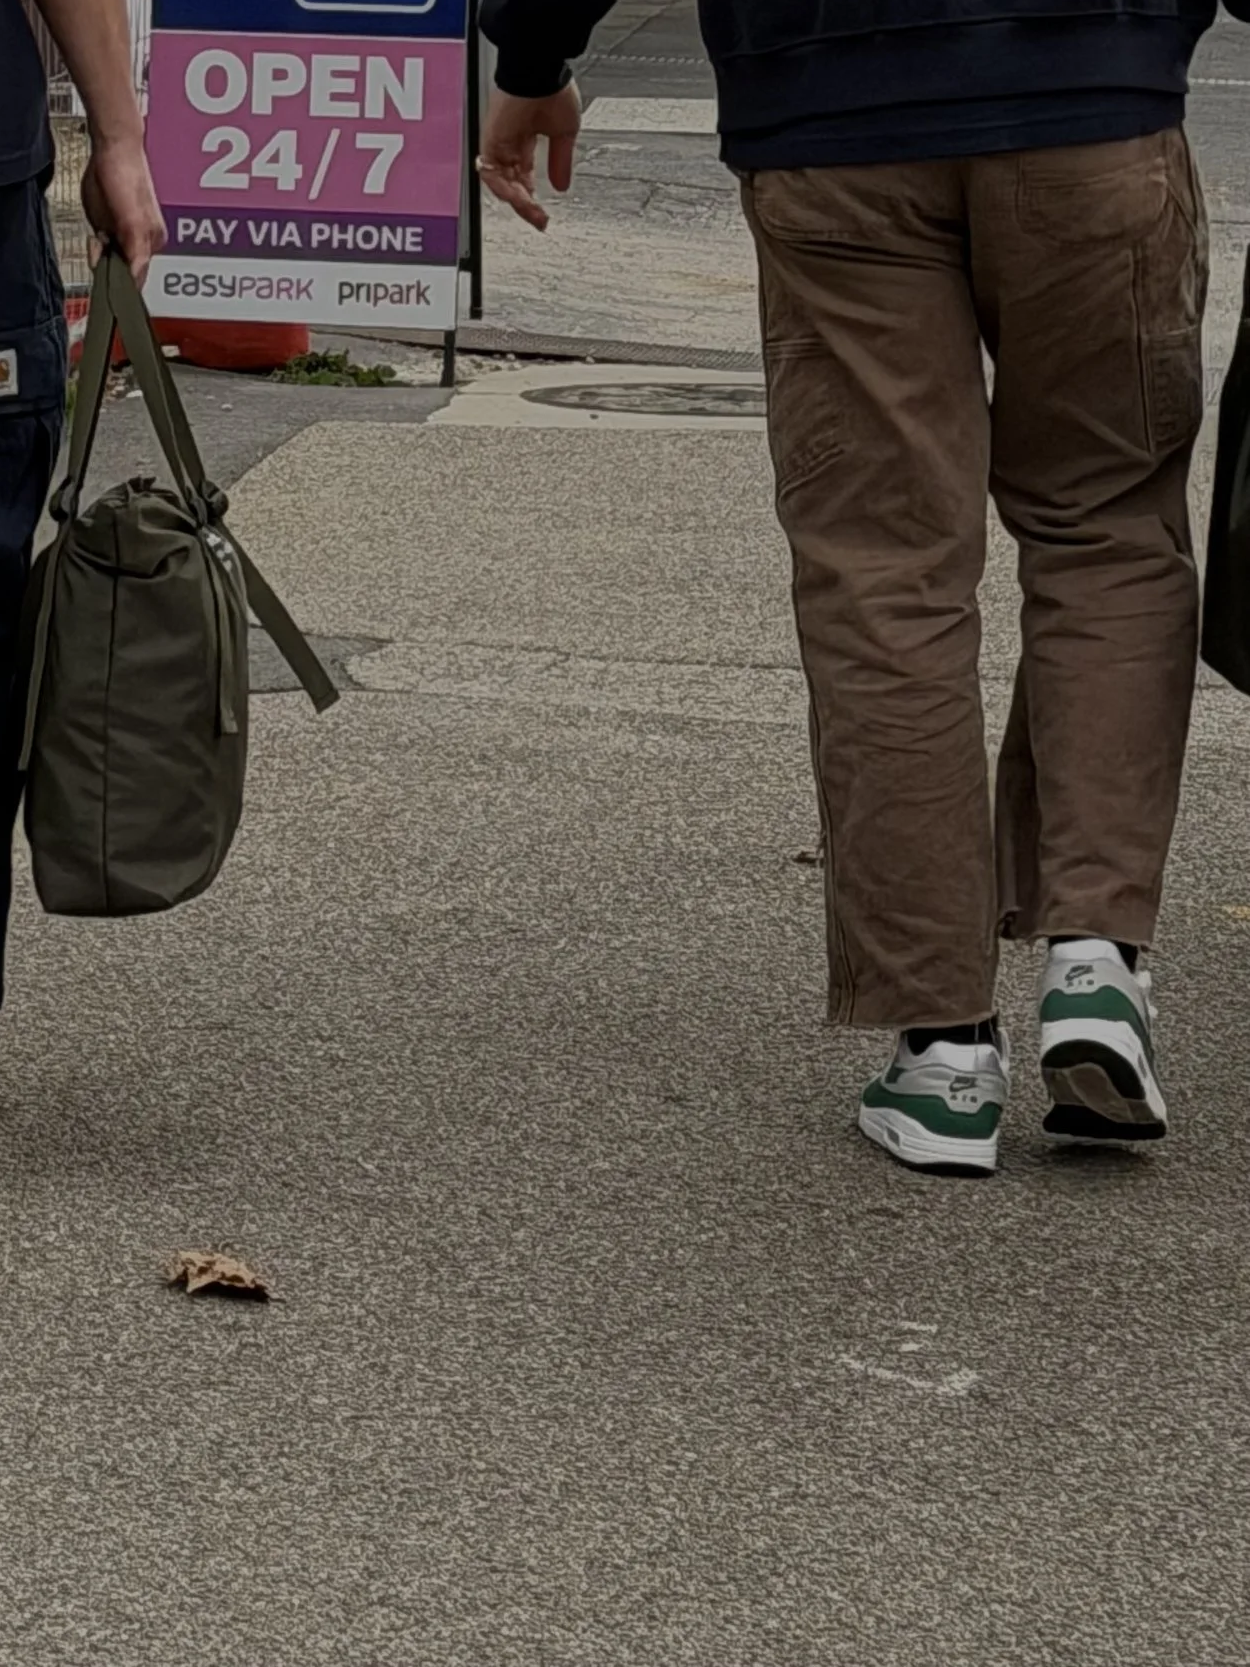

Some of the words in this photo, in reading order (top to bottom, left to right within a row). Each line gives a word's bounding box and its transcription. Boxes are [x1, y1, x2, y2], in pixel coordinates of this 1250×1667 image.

[185, 49, 424, 121] OPEN
[199, 126, 405, 201] 24/7
[176, 217, 239, 245] PAY
[246, 220, 303, 248] VIA
[310, 222, 424, 253] PHONE
